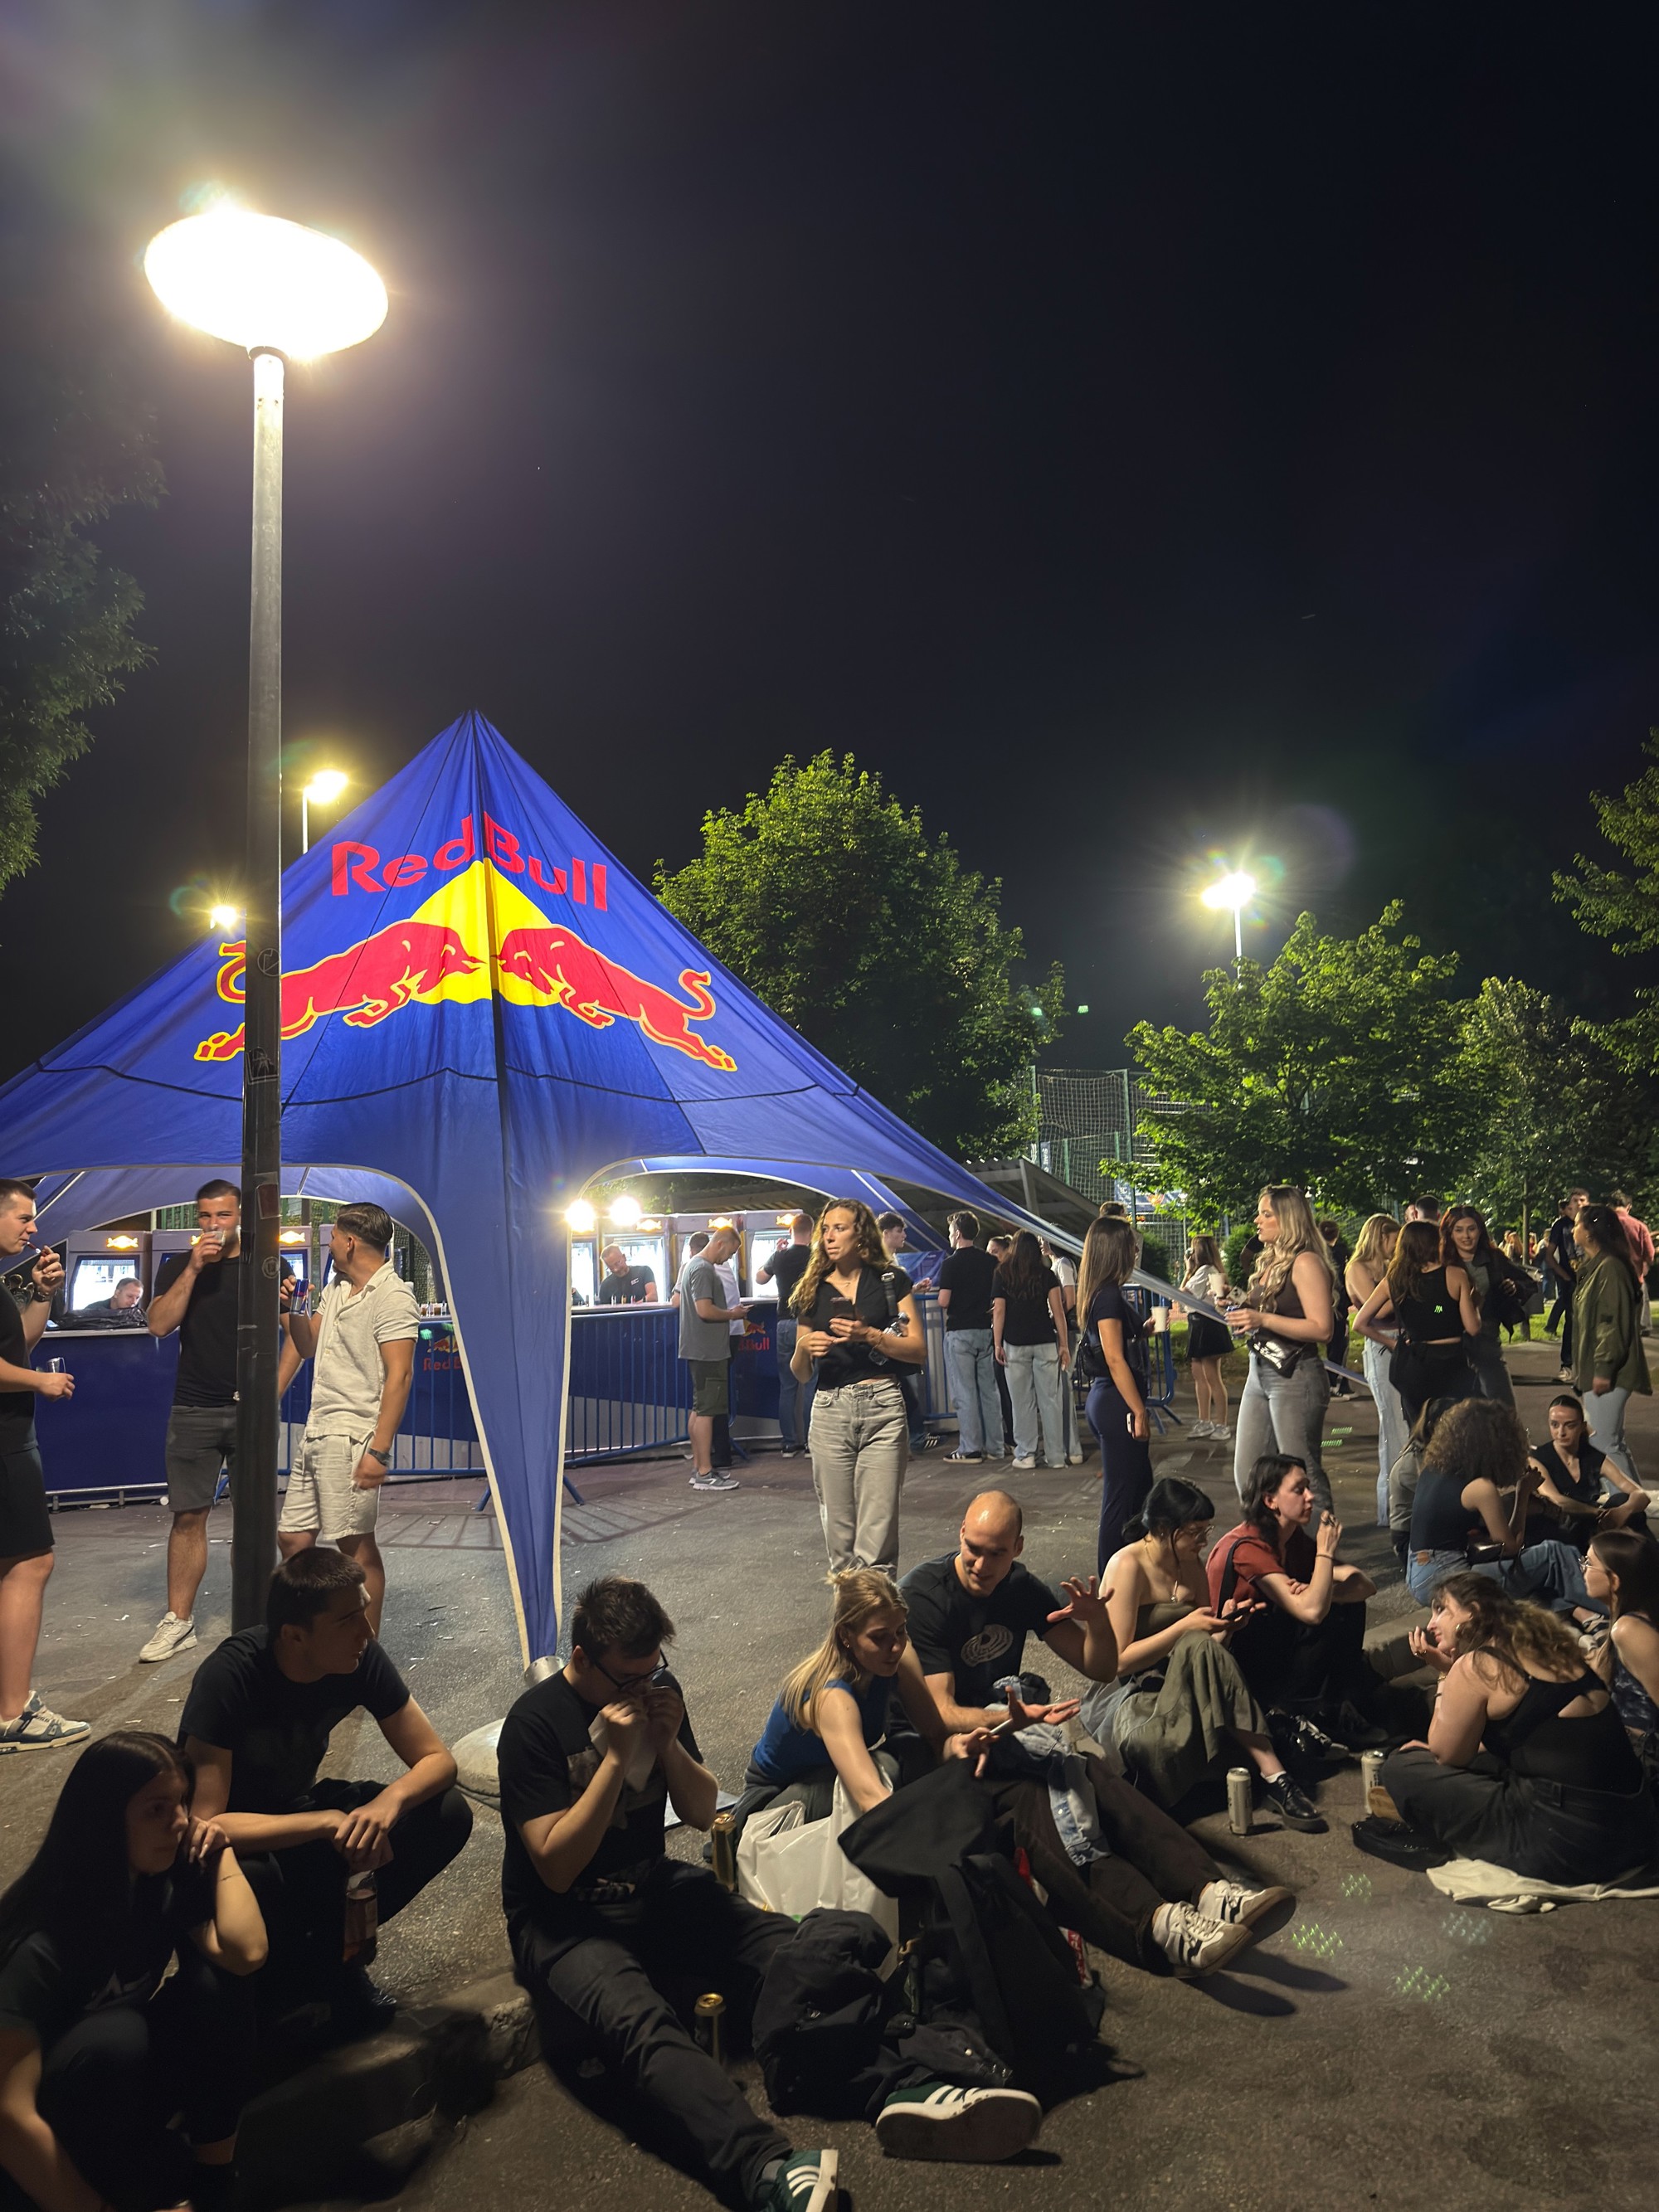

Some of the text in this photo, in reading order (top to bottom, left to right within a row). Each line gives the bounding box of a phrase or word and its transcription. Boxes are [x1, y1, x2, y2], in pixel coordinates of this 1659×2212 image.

[332, 811, 607, 912] Red Bull
[423, 1355, 450, 1372] Red
